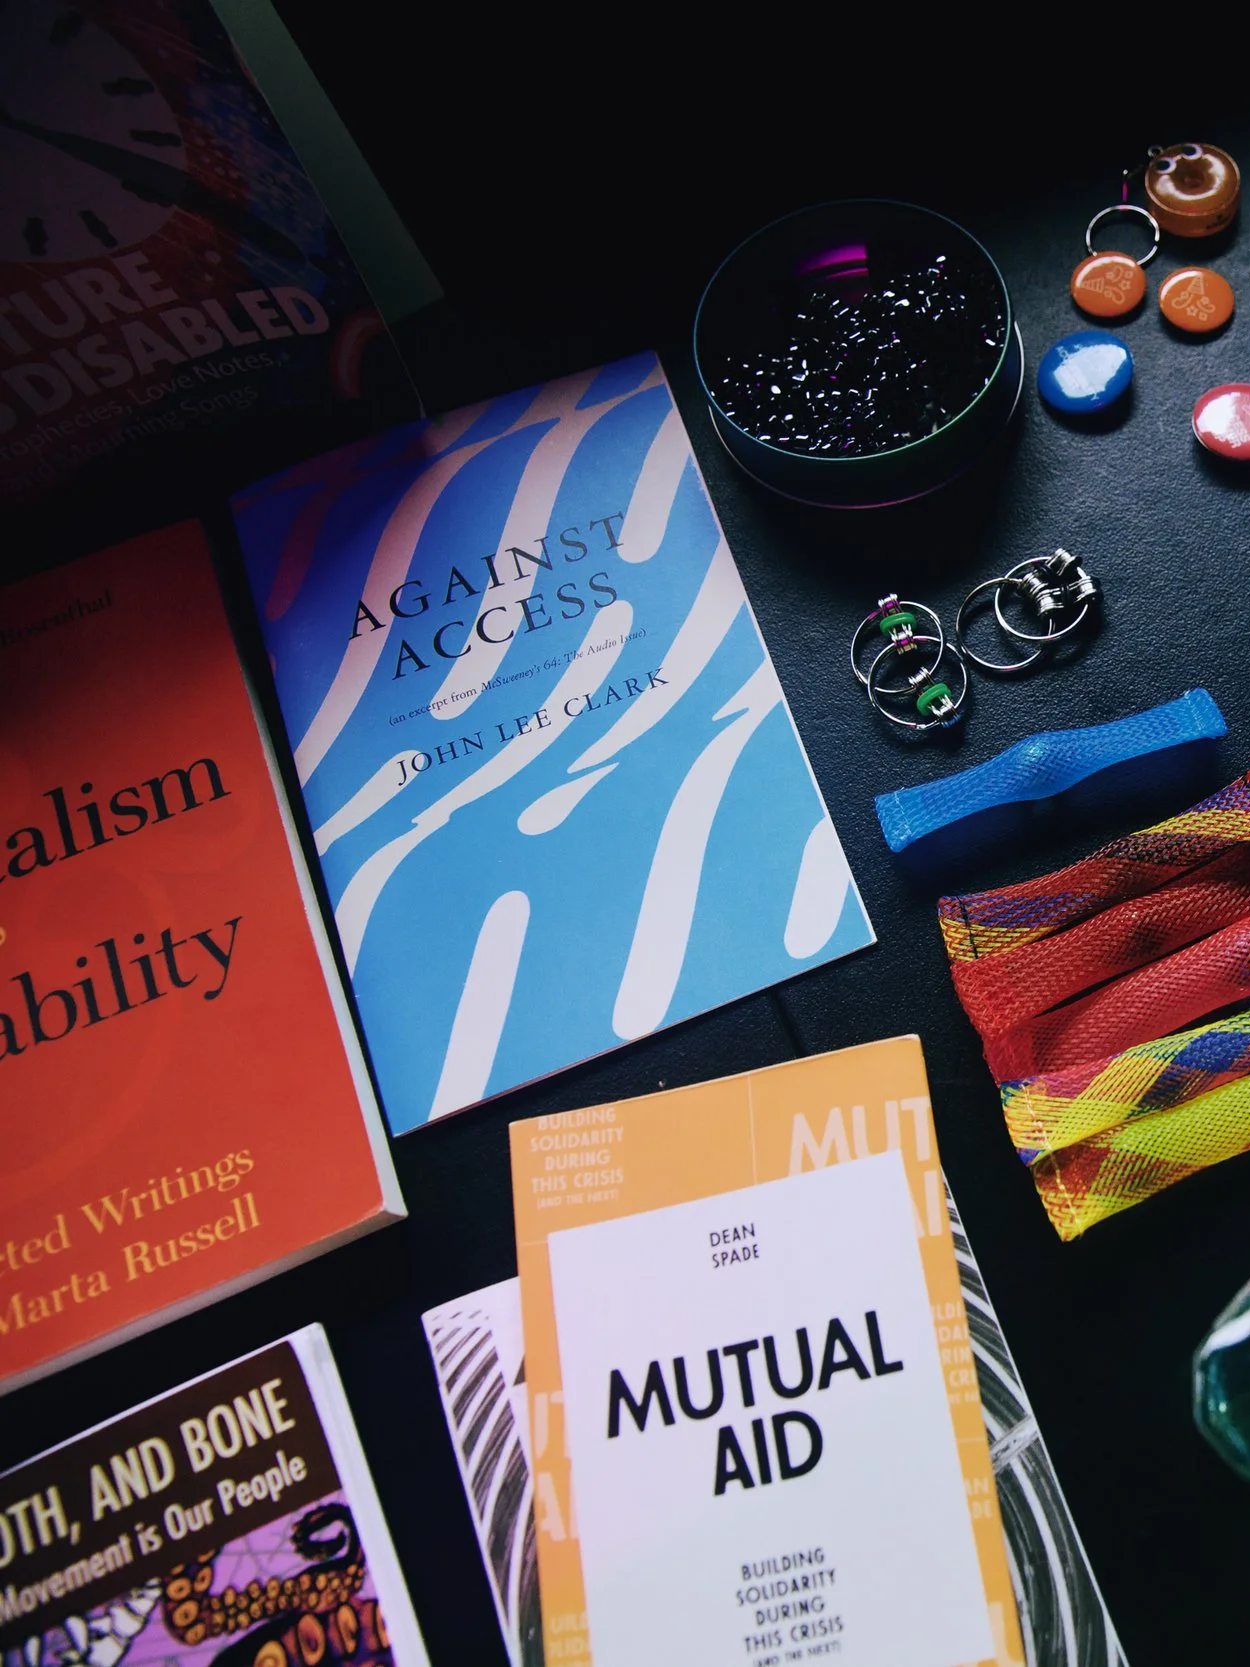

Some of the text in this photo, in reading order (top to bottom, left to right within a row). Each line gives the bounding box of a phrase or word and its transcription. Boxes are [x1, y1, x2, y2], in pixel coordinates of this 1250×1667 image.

[3, 285, 331, 417] DISABLED
[127, 372, 194, 406] Love
[191, 350, 283, 386] Notes,
[179, 382, 259, 418] Songs
[349, 512, 624, 641] AGAINST
[392, 572, 617, 681] ACCESS
[389, 627, 647, 727] (an excerpt from McSweeney's 64: The Audio Issue)
[397, 667, 670, 787] JOHN LEE CLARK
[0, 756, 232, 881] alism
[530, 1126, 624, 1153] SOLIDARITY
[537, 1107, 617, 1132] BUILDING
[544, 1148, 611, 1172] DURING
[788, 1095, 932, 1177] MUT
[0, 1149, 255, 1278] ted Writings
[530, 1168, 625, 1195] THIS CRISIS
[122, 1192, 261, 1283] Russell
[709, 1222, 756, 1248] DEAN
[712, 1244, 760, 1269] SPADE
[607, 1310, 904, 1440] MUTUAL
[90, 1436, 175, 1522] AND
[180, 1378, 296, 1473] BONE
[713, 1410, 824, 1497] AID
[0, 1450, 308, 1625] Movement is Our People
[741, 1547, 825, 1582] BUILDING
[735, 1568, 836, 1608] SOLIDARITY
[756, 1595, 825, 1627] DURING
[744, 1614, 845, 1654] THIS CRISIS
